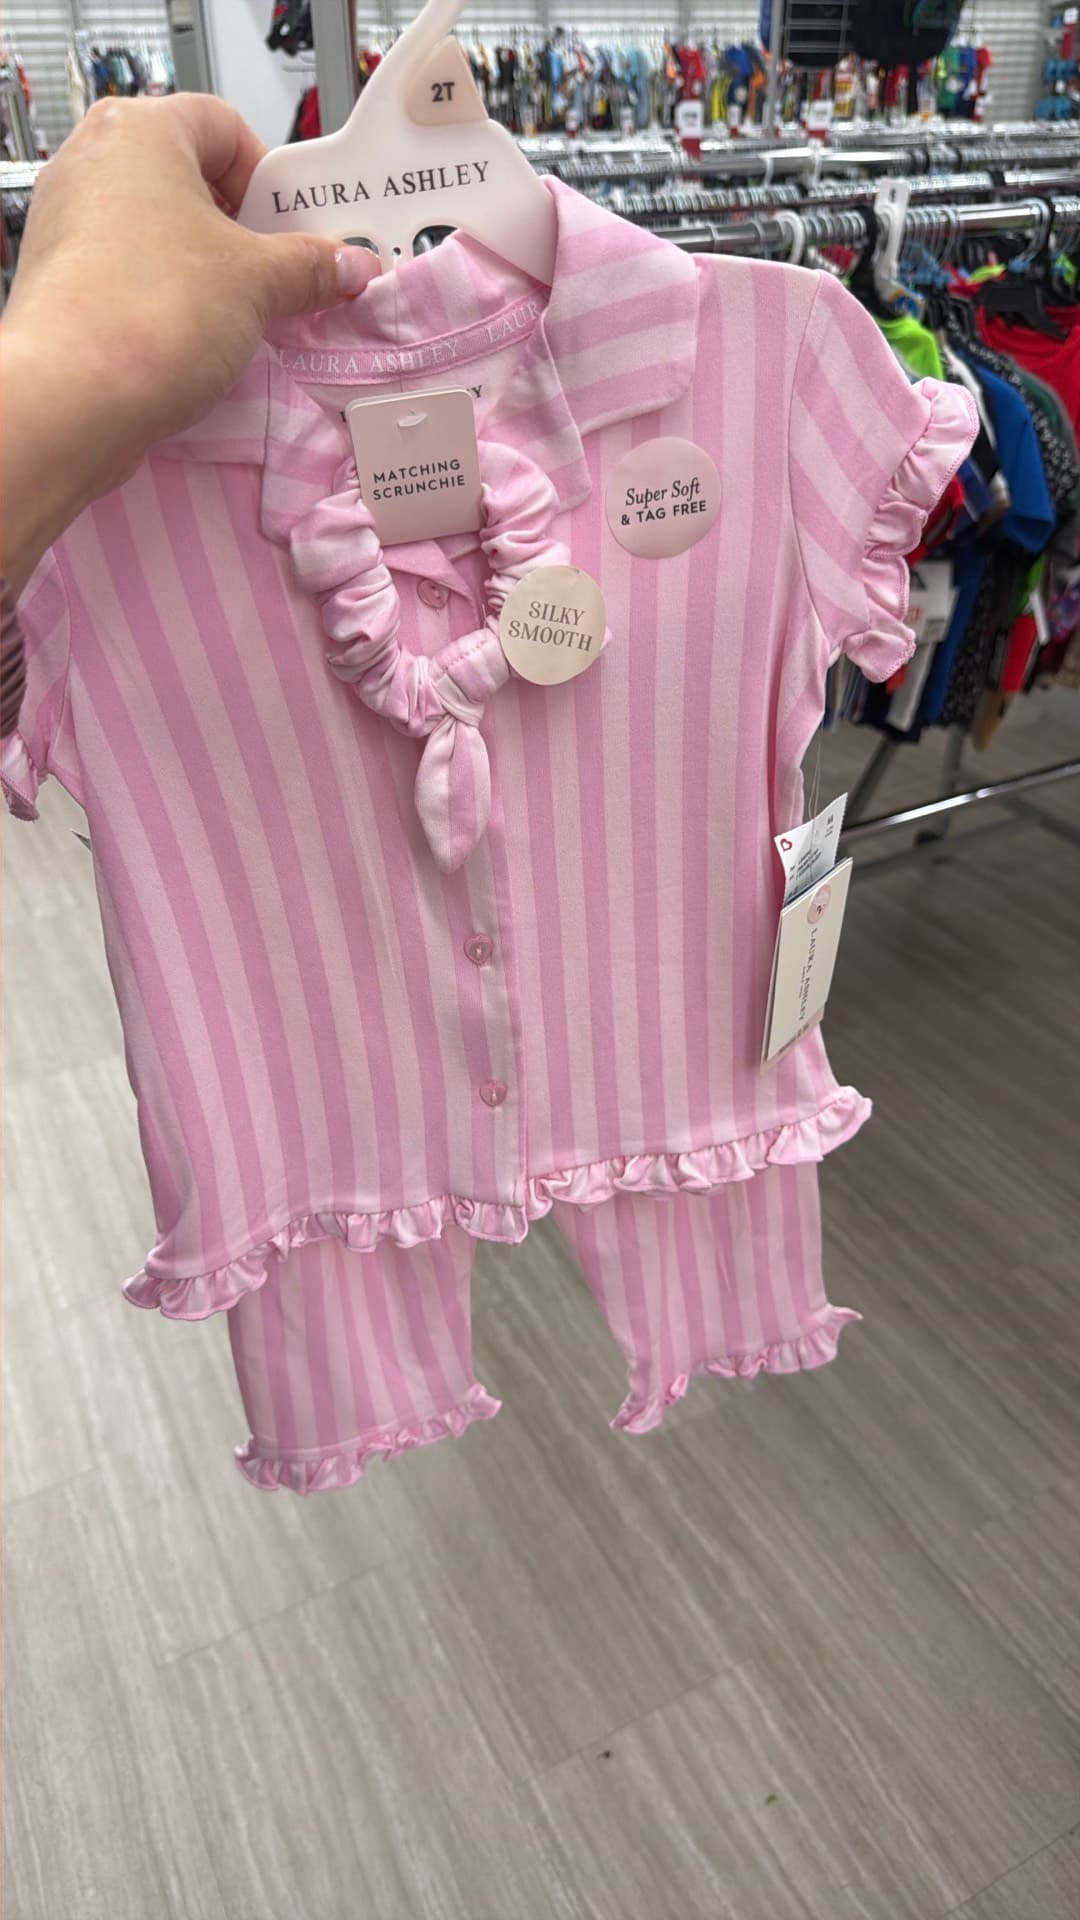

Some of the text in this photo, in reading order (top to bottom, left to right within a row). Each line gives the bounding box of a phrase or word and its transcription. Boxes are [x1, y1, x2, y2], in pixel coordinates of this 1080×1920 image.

[431, 82, 455, 103] 2T
[271, 160, 490, 214] LAURA ASHLEY
[279, 351, 359, 374] LAURA
[369, 341, 460, 374] ASHLEY
[373, 458, 461, 484] MATCHING
[372, 474, 466, 501] SCRUNCHIE
[625, 477, 701, 508] Super Soft
[620, 499, 707, 526] & TAG FREE
[528, 601, 585, 627] SILKY
[508, 620, 593, 652] SMOOTH
